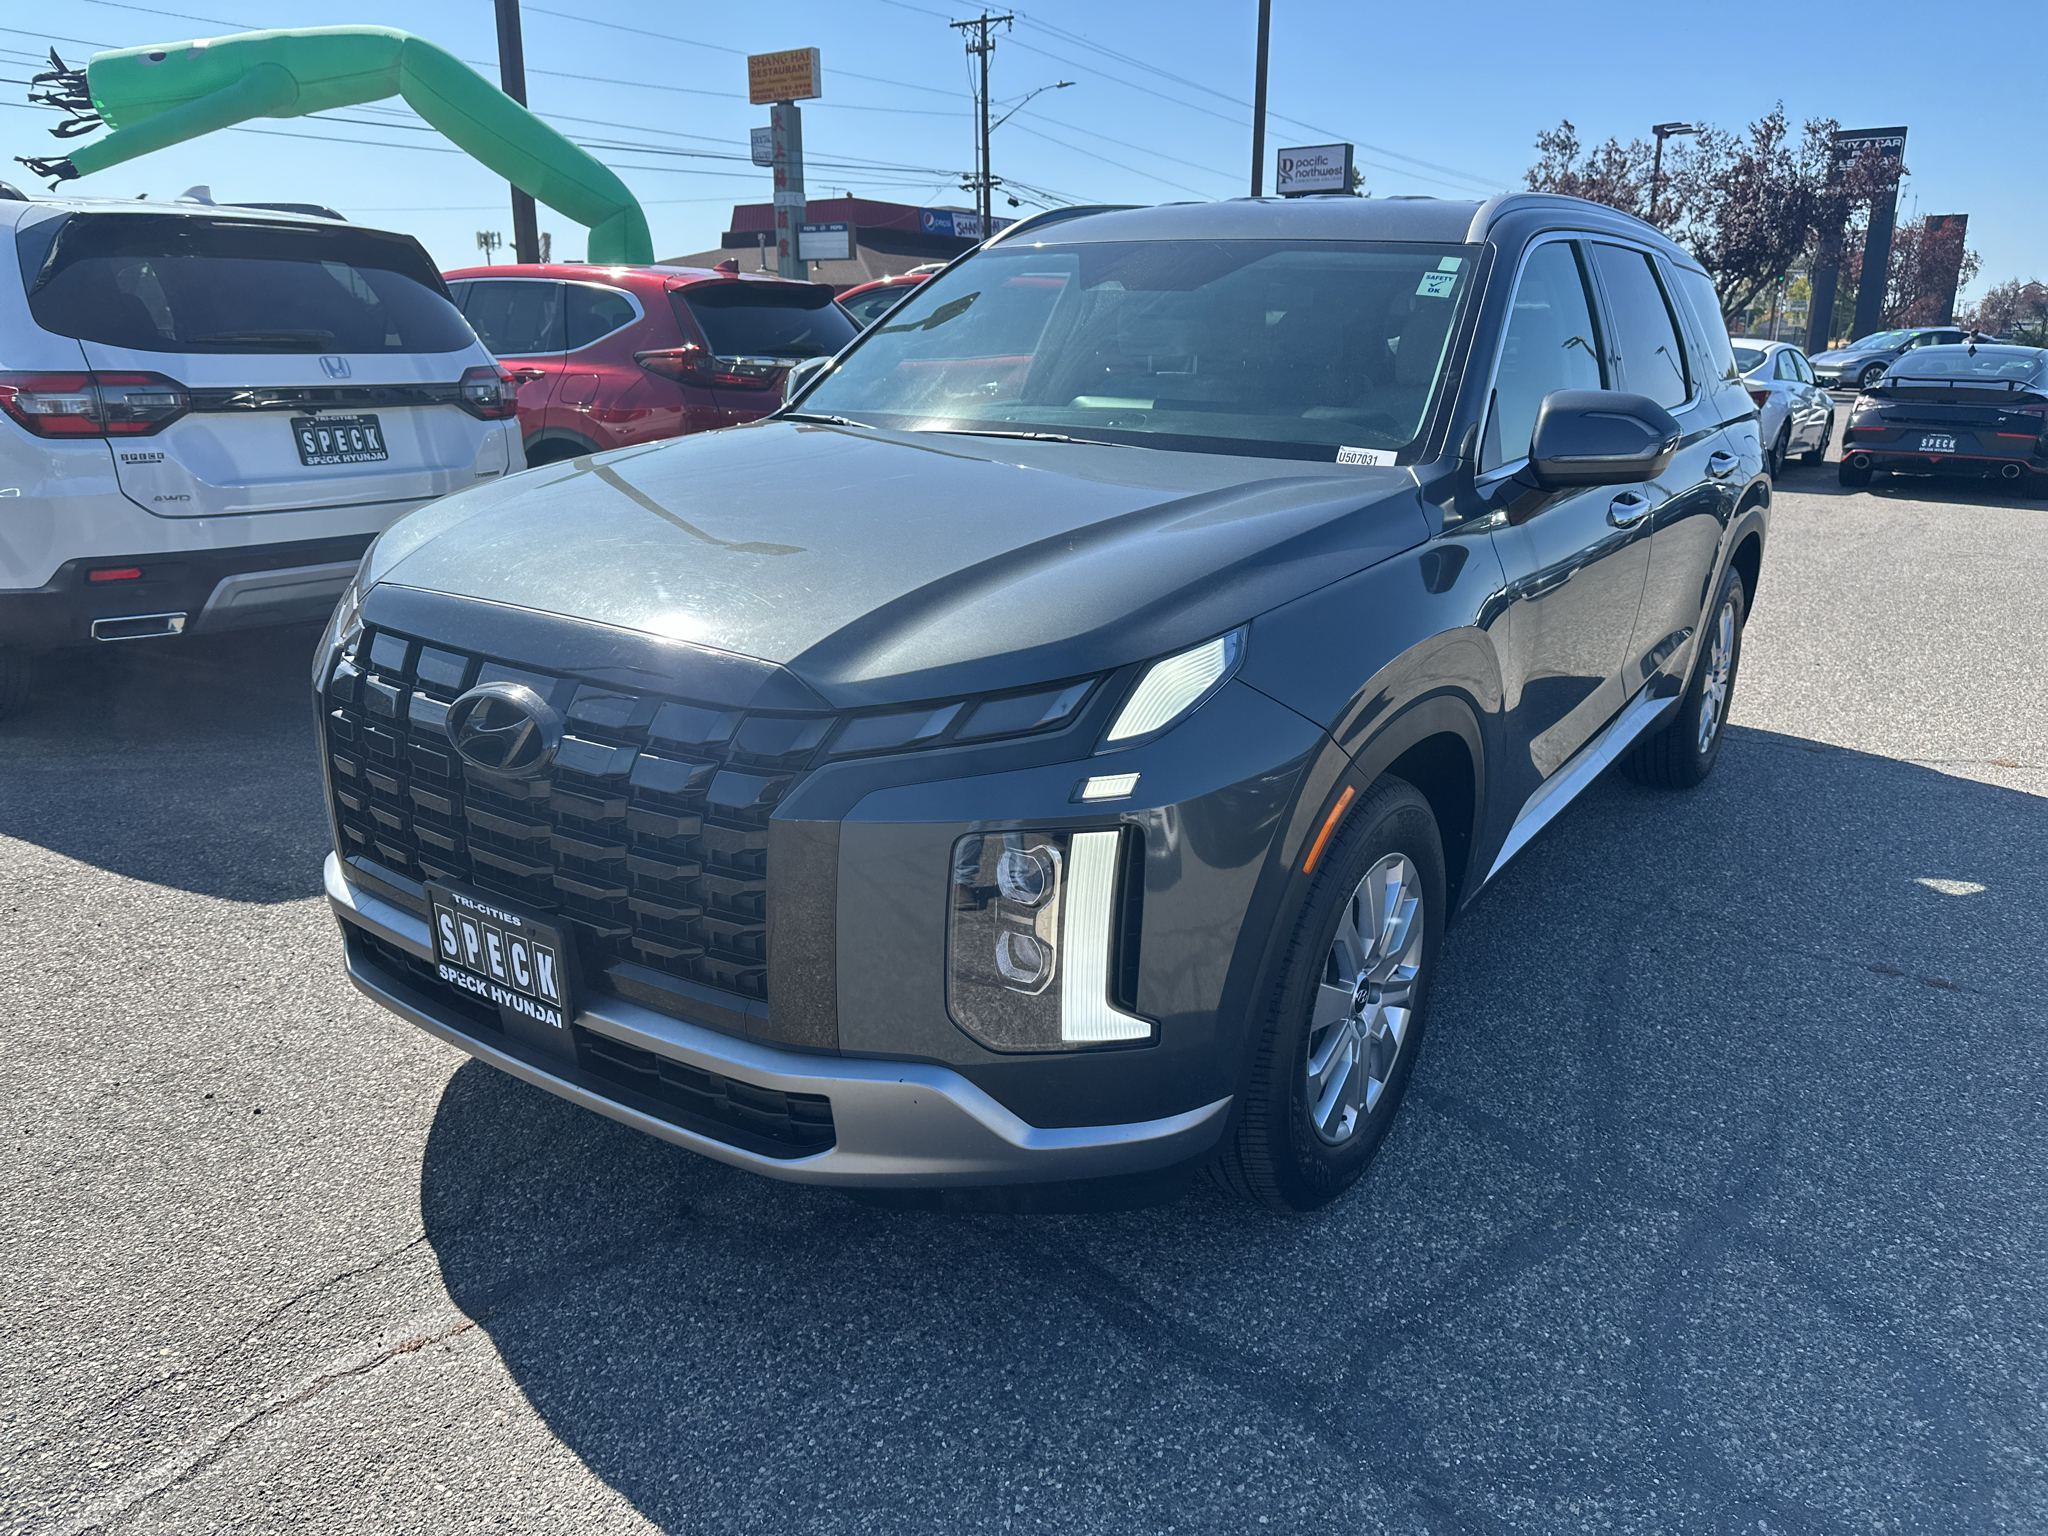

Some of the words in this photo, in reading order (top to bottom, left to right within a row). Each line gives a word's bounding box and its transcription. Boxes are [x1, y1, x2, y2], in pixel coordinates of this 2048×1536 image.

[751, 52, 788, 69] SHANG
[790, 50, 809, 63] HAI
[751, 63, 810, 78] RESTAURANT
[1863, 140, 1871, 148] A
[1295, 155, 1328, 170] pacific
[1295, 165, 1343, 178] northwest
[935, 218, 952, 228] pepsi
[303, 428, 380, 453] SPECK
[1921, 438, 1957, 449] SPECK
[120, 452, 165, 461] SPECK
[307, 455, 342, 465] SPECK
[343, 452, 387, 462] HYUNDAI
[1338, 452, 1378, 466] U507031
[152, 494, 191, 503] AWD
[452, 893, 522, 926] TRI-CITIES
[440, 913, 558, 999] SPECK
[438, 964, 488, 998] SPECK
[491, 985, 563, 1029] HYUNDAI
